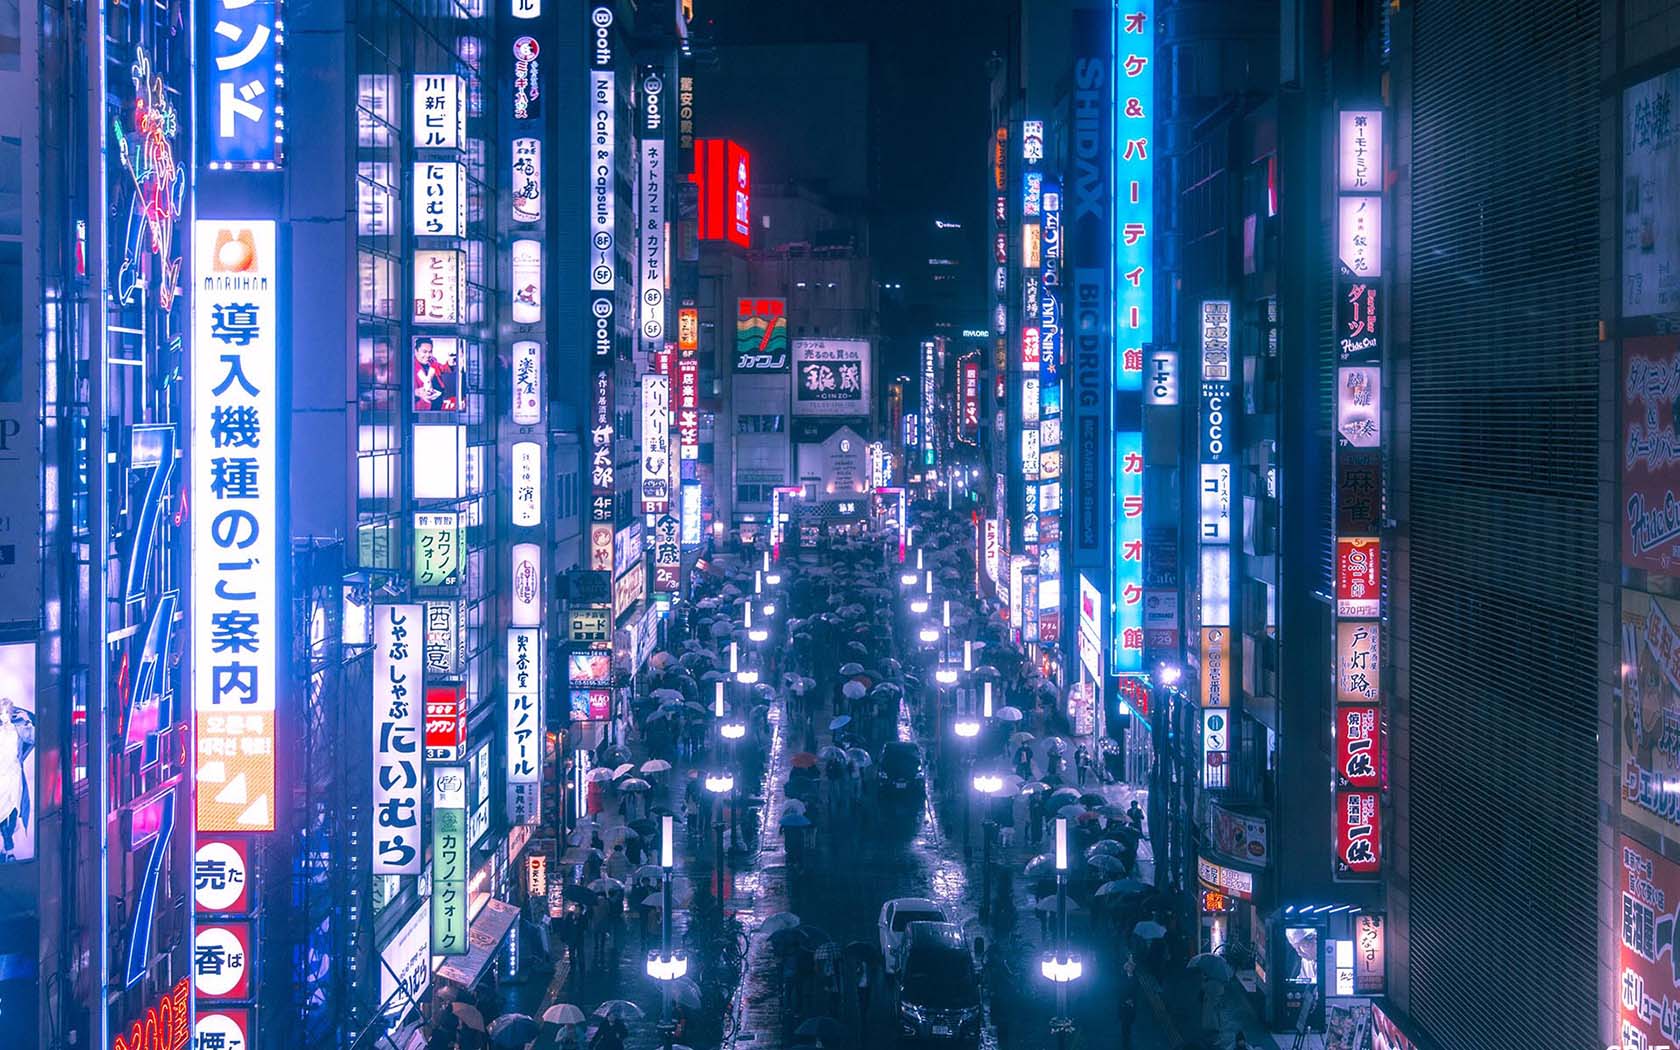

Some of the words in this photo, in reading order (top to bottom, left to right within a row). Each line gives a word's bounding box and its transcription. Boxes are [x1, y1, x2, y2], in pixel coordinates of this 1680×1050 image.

[592, 7, 613, 65] Booth
[214, 0, 271, 137] ンド
[597, 80, 608, 104] Net
[425, 78, 446, 146] 川新ビル
[597, 110, 608, 145] Cafe
[644, 76, 661, 129] Booth
[597, 150, 608, 159] &
[1075, 57, 1105, 221] SHIDAX
[426, 165, 444, 233] にいむら
[595, 165, 609, 224] Capsule
[647, 147, 659, 214] ネットカフェ
[648, 219, 658, 230] &
[592, 298, 613, 355] Booth
[1079, 283, 1099, 329] BIC
[1348, 283, 1366, 338] ダーツ
[804, 350, 859, 360] 売るのも買うのも
[1079, 335, 1099, 407] DRUG
[1209, 397, 1223, 454] COCO
[592, 424, 613, 489] 甘太郎
[211, 302, 261, 705] 導入機種のご案内
[593, 497, 612, 508] 4F
[593, 509, 612, 520] 3F
[646, 501, 663, 513] B1
[1204, 479, 1218, 537] ココ
[656, 514, 680, 564] 金の蔵
[1123, 453, 1143, 650] カラオケ館
[656, 569, 673, 582] 2F
[573, 620, 606, 631] ロード
[388, 606, 409, 720] しゃぶしゃぶ
[516, 634, 530, 689] 喫茶室
[513, 695, 535, 776] ルノアール
[378, 721, 417, 867] にいむら
[1348, 795, 1360, 825] 居酒屋
[195, 860, 226, 890] 売
[441, 835, 457, 949] カワノ・クォーク
[195, 944, 226, 975] 香
